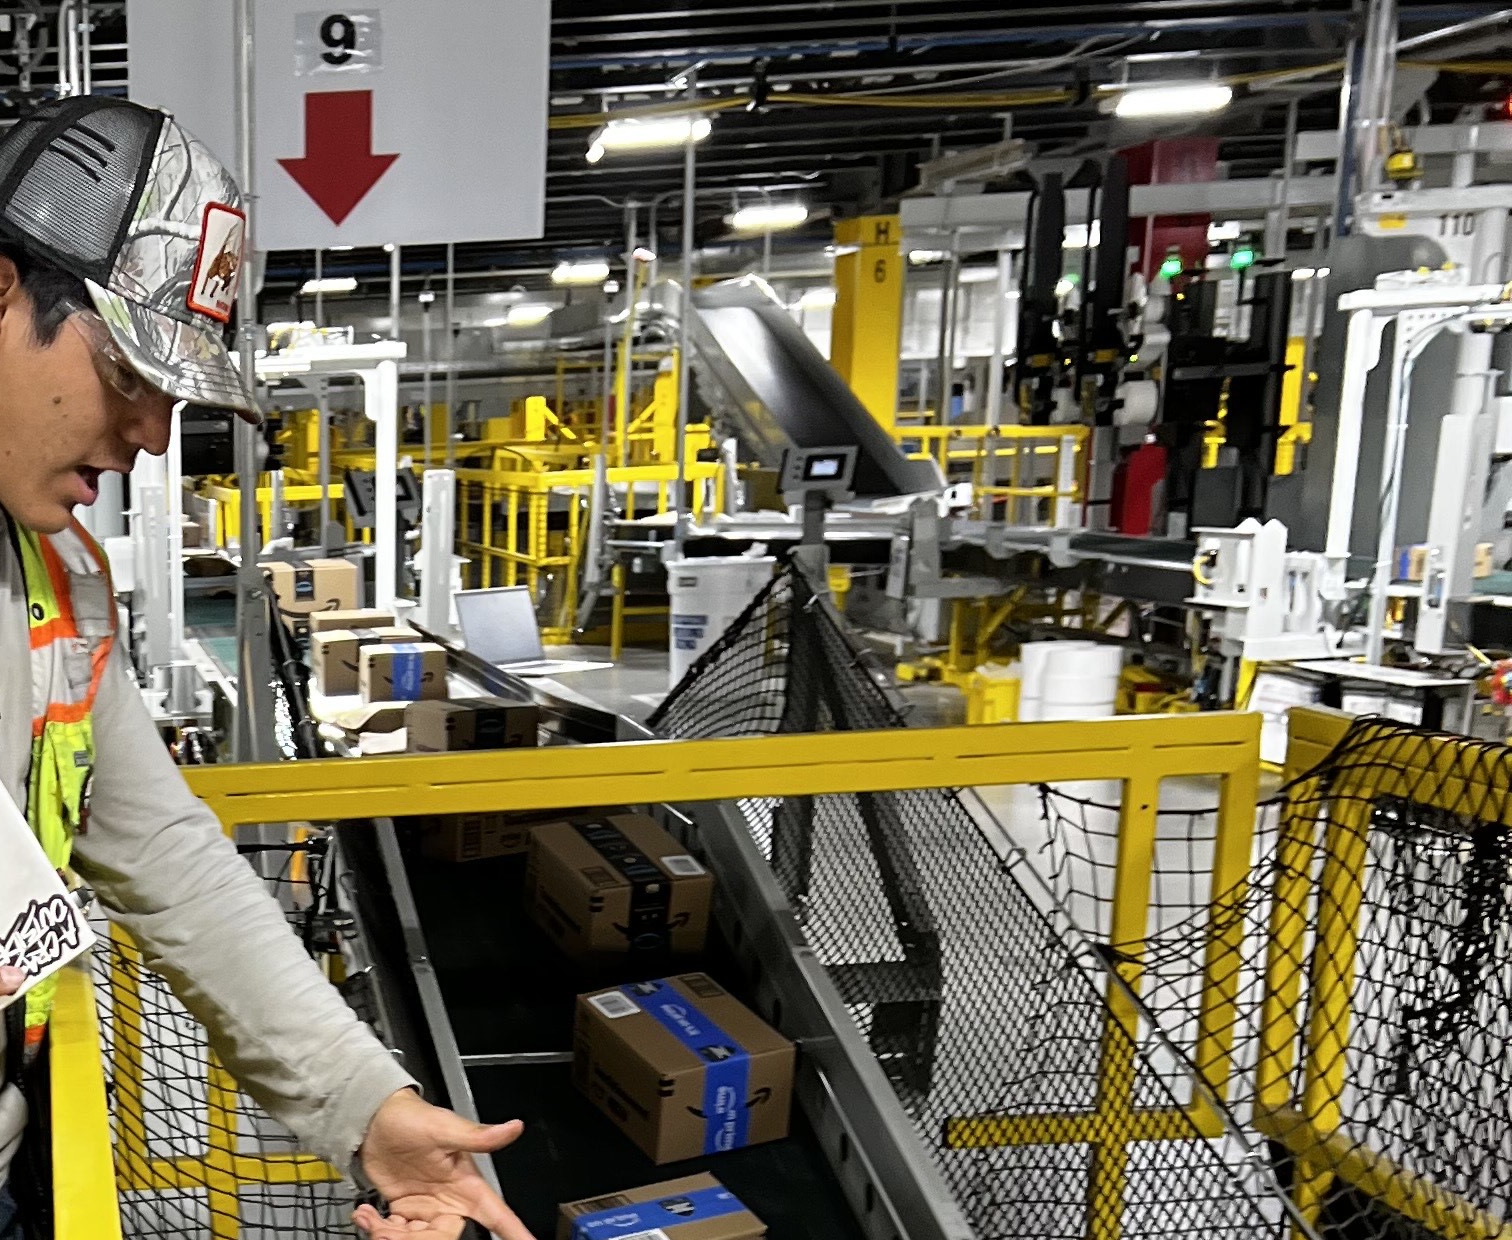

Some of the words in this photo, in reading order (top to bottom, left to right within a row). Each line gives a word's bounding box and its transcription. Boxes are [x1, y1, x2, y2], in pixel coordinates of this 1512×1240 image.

[319, 14, 356, 65] 9
[875, 221, 890, 244] H
[873, 258, 886, 283] 6
